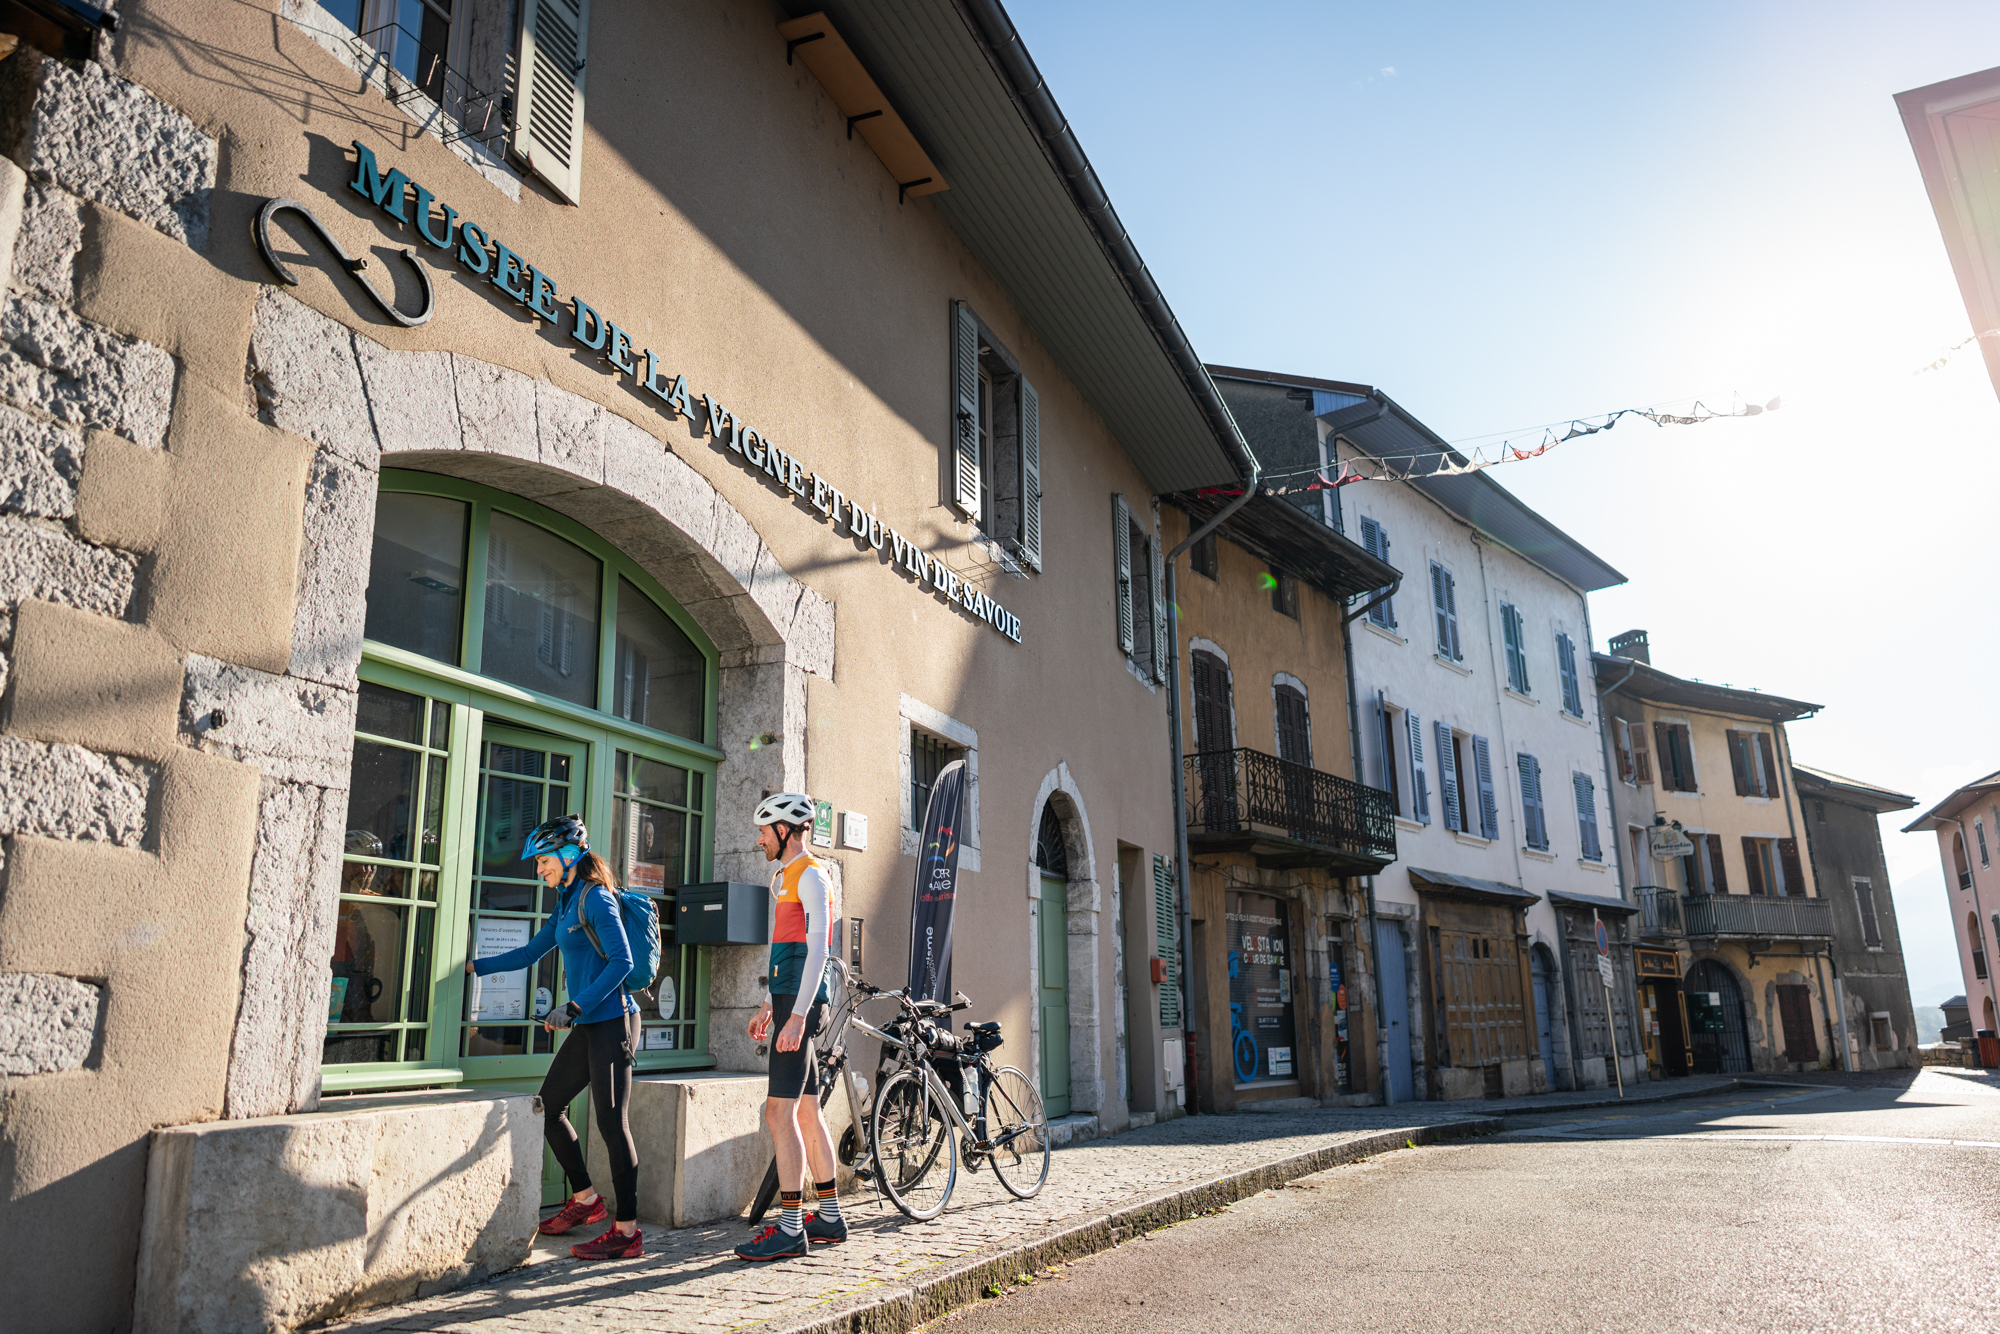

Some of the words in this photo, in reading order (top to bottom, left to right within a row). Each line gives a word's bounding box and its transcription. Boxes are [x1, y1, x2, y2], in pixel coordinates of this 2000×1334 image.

[347, 140, 559, 325] MUSEE
[569, 296, 635, 376] DE
[643, 348, 697, 421] LA
[703, 393, 805, 497] VIGNE
[809, 472, 845, 523] ET
[848, 499, 886, 550] DU
[888, 528, 930, 582] VIN
[931, 558, 960, 603] DE
[961, 581, 1022, 645] SAVOIE
[1241, 932, 1284, 954] VÉLOSTATION
[1260, 954, 1267, 965] DE
